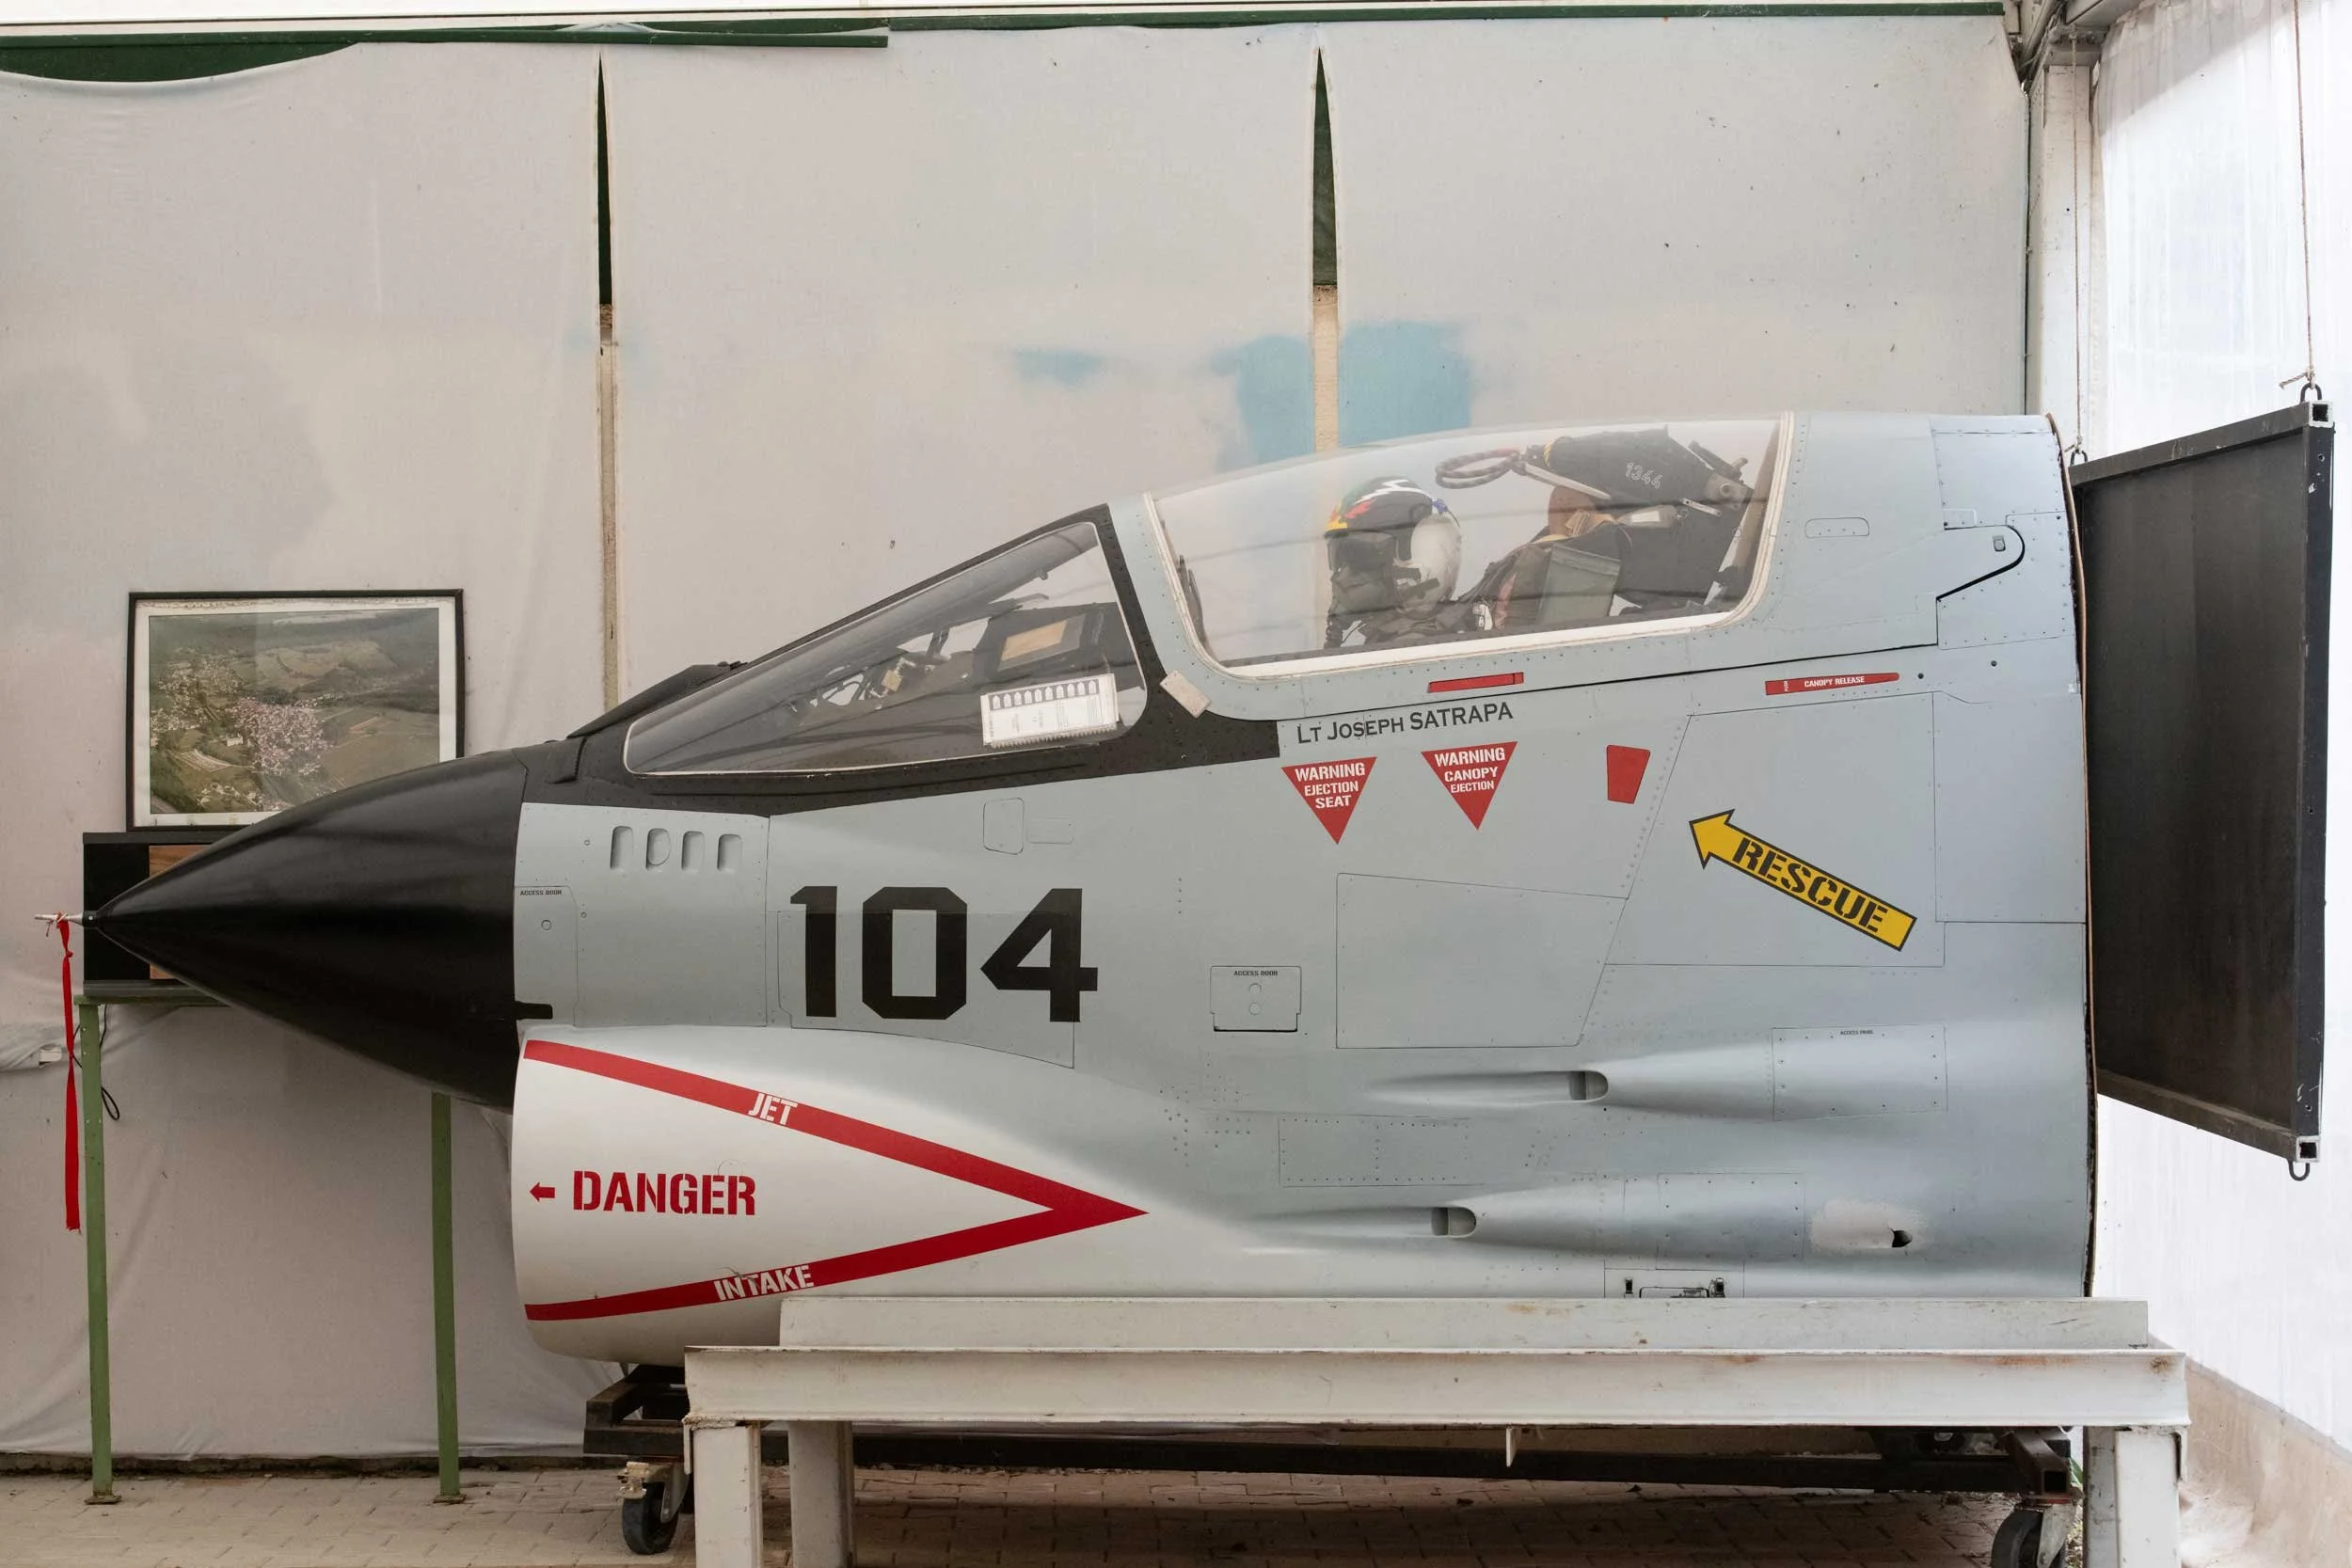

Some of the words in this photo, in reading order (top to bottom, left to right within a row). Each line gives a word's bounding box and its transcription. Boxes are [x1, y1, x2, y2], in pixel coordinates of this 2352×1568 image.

[1804, 679, 1834, 688] CANOPY
[1835, 676, 1865, 686] RELEASE
[1410, 702, 1514, 730] SATRAPA
[1434, 746, 1506, 768] WARNING
[1295, 762, 1366, 782] WARNING
[1443, 766, 1499, 783] CANOPY
[1304, 780, 1359, 797] EJECTION
[1450, 780, 1495, 793] EJECTION
[1314, 795, 1352, 809] SEAT
[1732, 837, 1888, 933] RESCUE
[790, 885, 1099, 1022] 104
[748, 1092, 798, 1126] JET
[573, 1170, 755, 1216] DANGER
[713, 1264, 814, 1302] INTAKE
